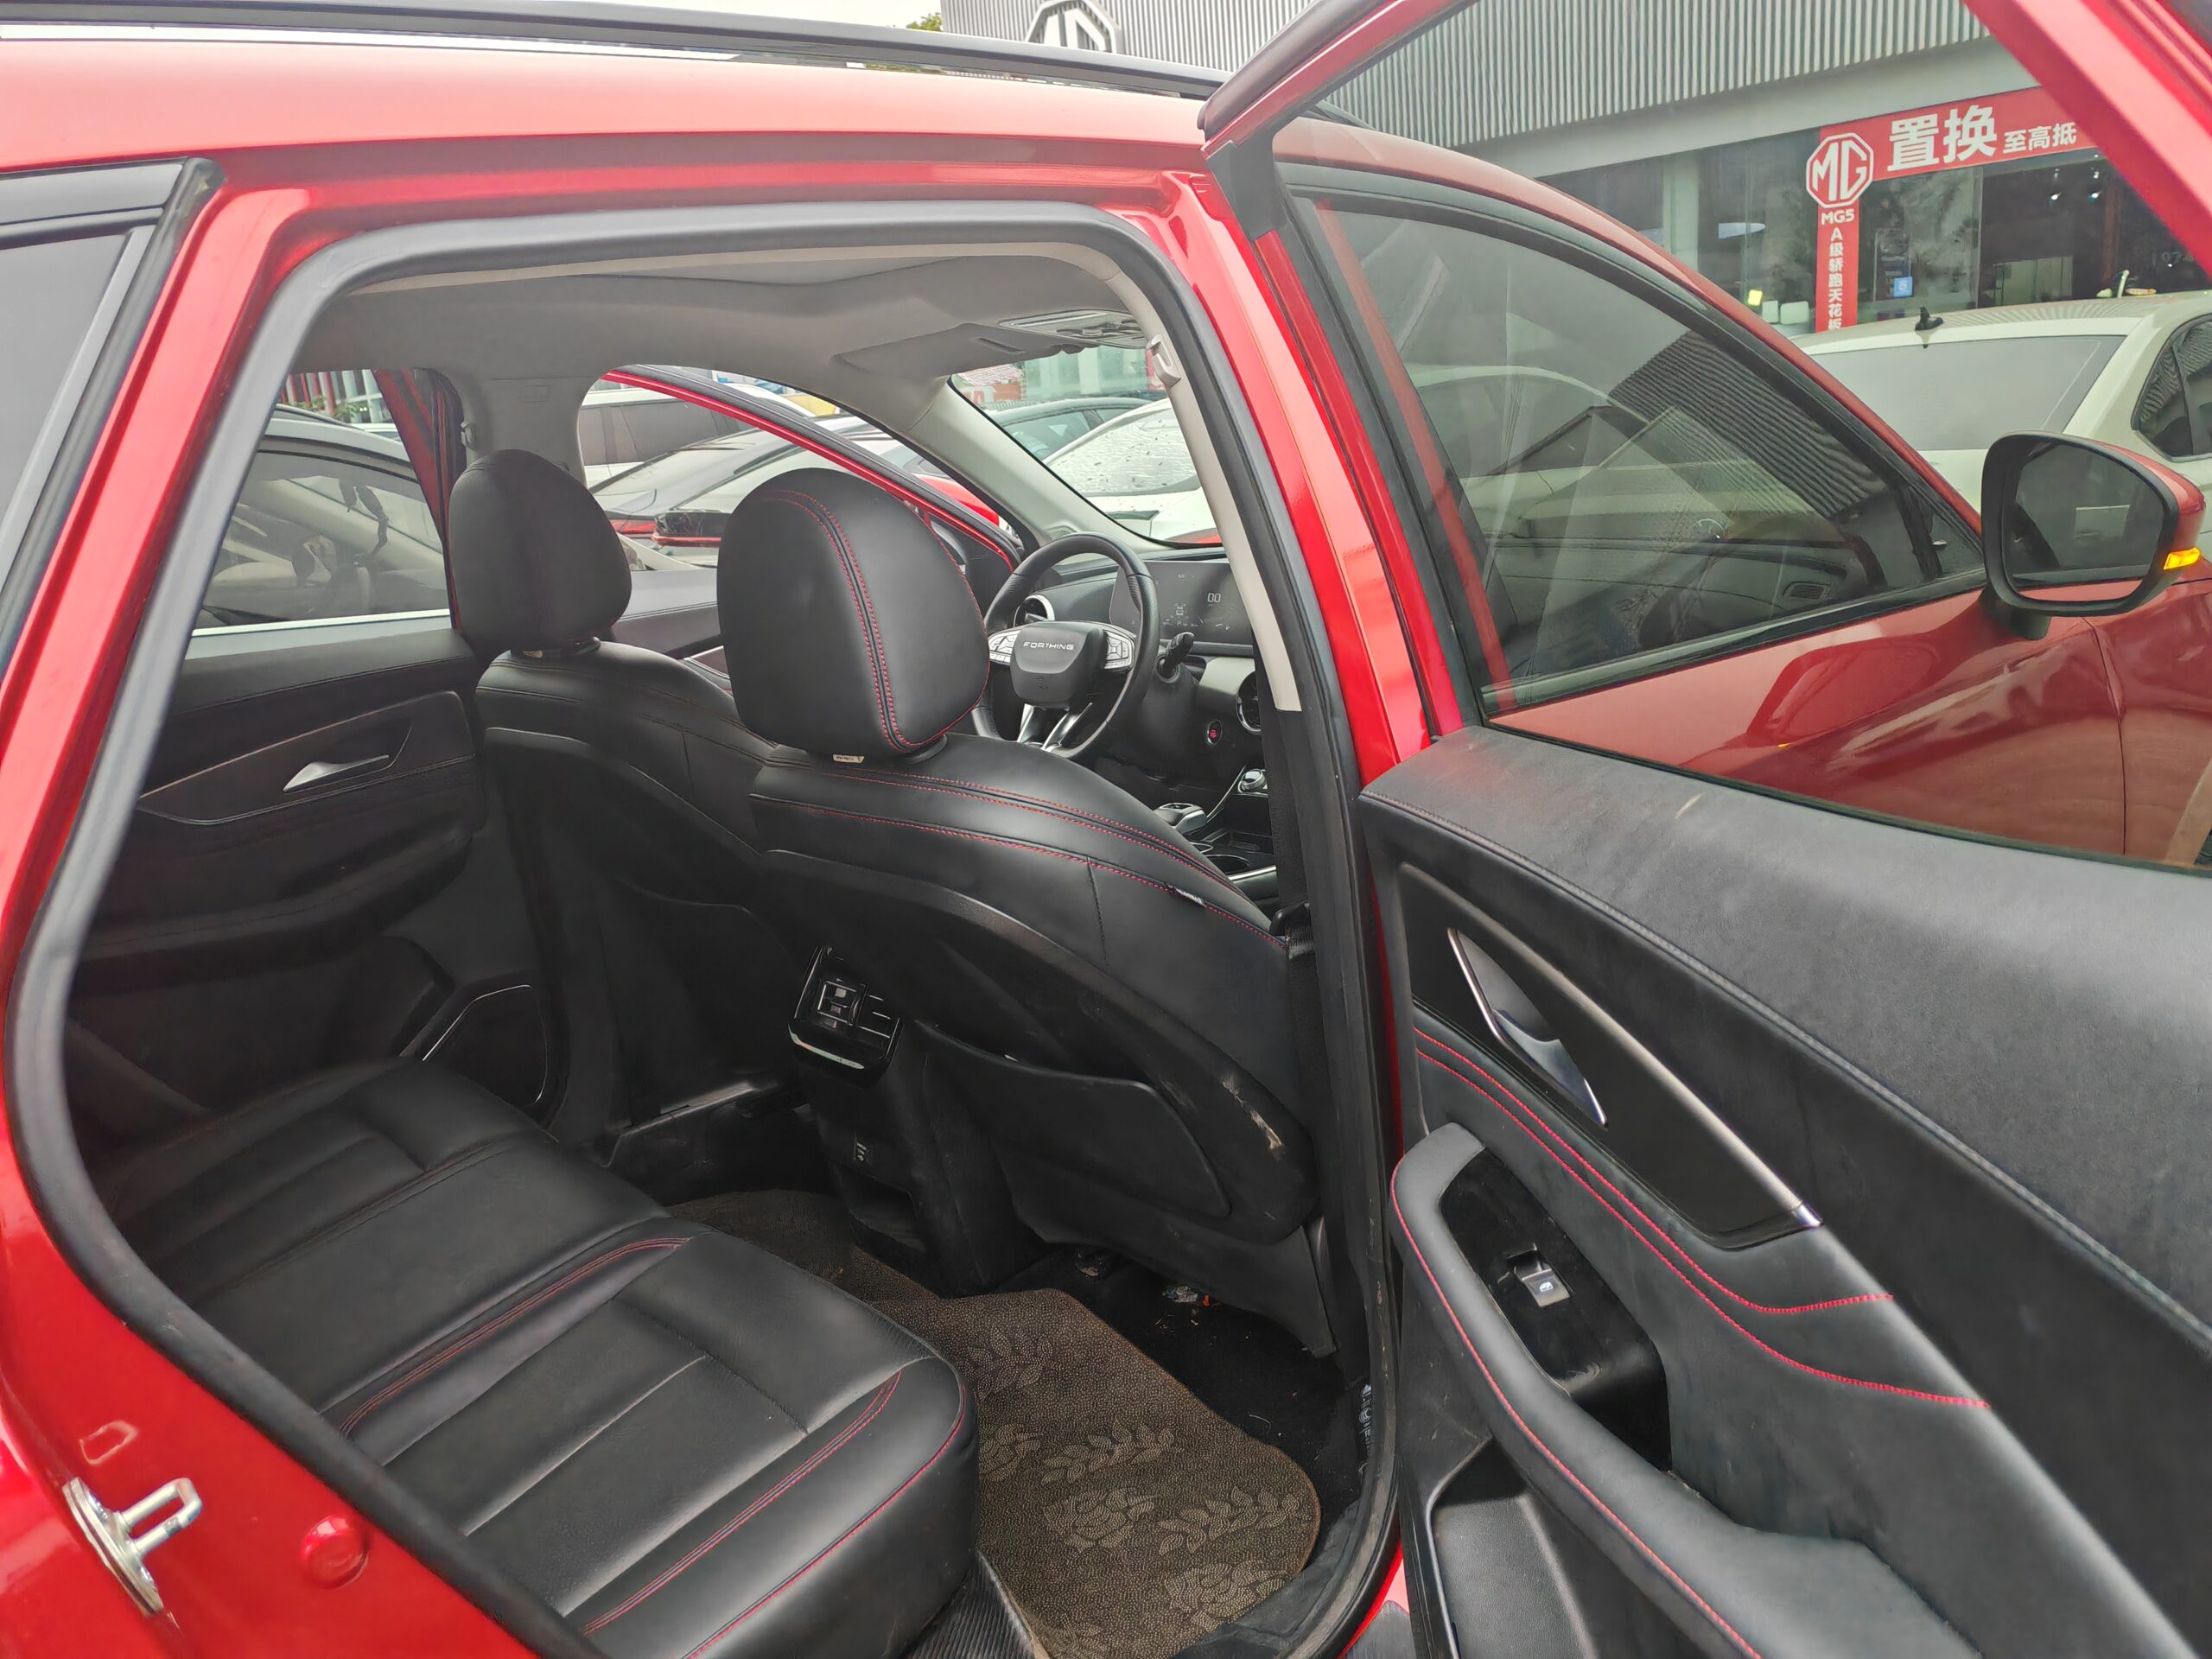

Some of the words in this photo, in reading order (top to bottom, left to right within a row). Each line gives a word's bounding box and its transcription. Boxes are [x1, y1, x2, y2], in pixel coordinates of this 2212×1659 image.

[1887, 105, 1997, 172] 置换
[2003, 122, 2076, 154] 至高抵
[1811, 139, 1867, 201] MG
[1821, 208, 1854, 225] MG5
[1023, 641, 1075, 651] FORTHING
